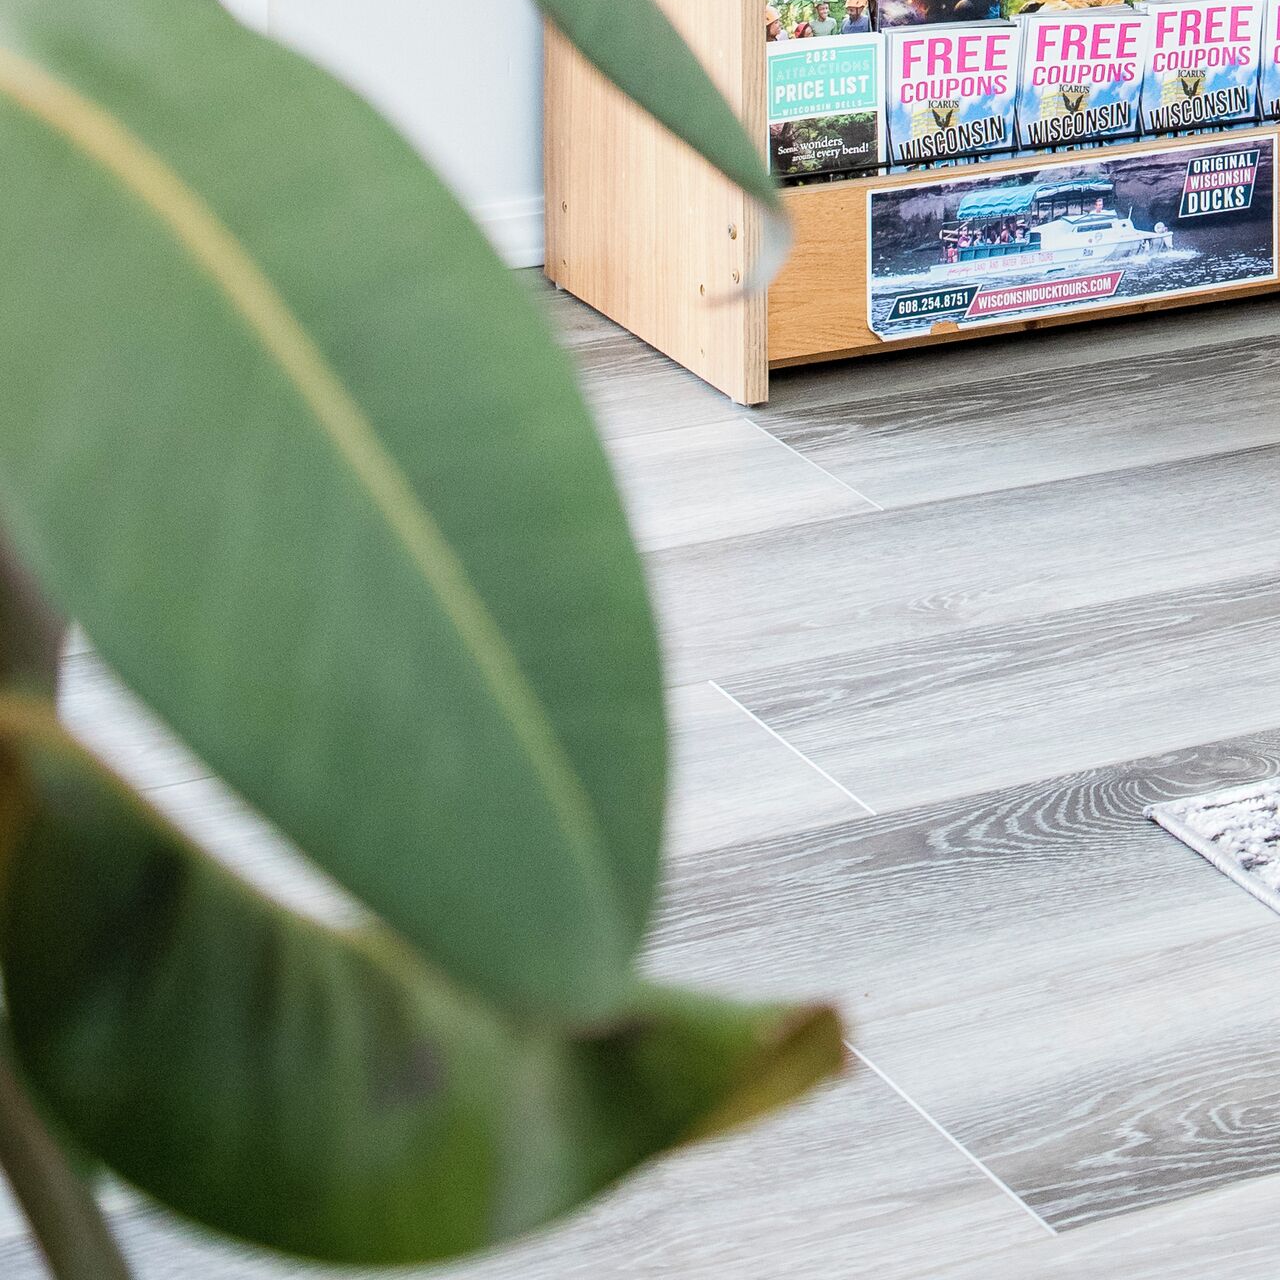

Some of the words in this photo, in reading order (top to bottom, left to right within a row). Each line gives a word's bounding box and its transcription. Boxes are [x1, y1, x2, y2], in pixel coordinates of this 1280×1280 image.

[775, 79, 824, 105] PRICE
[830, 75, 870, 96] LIST
[800, 137, 843, 152] wonders
[1193, 153, 1254, 173] ORIGINAL
[1189, 169, 1252, 191] WISCONSIN
[1187, 186, 1245, 214] DUCKS
[898, 291, 969, 315] 608.254.8751
[977, 277, 1112, 310] WISCONSINDUCKTOURS.COM
